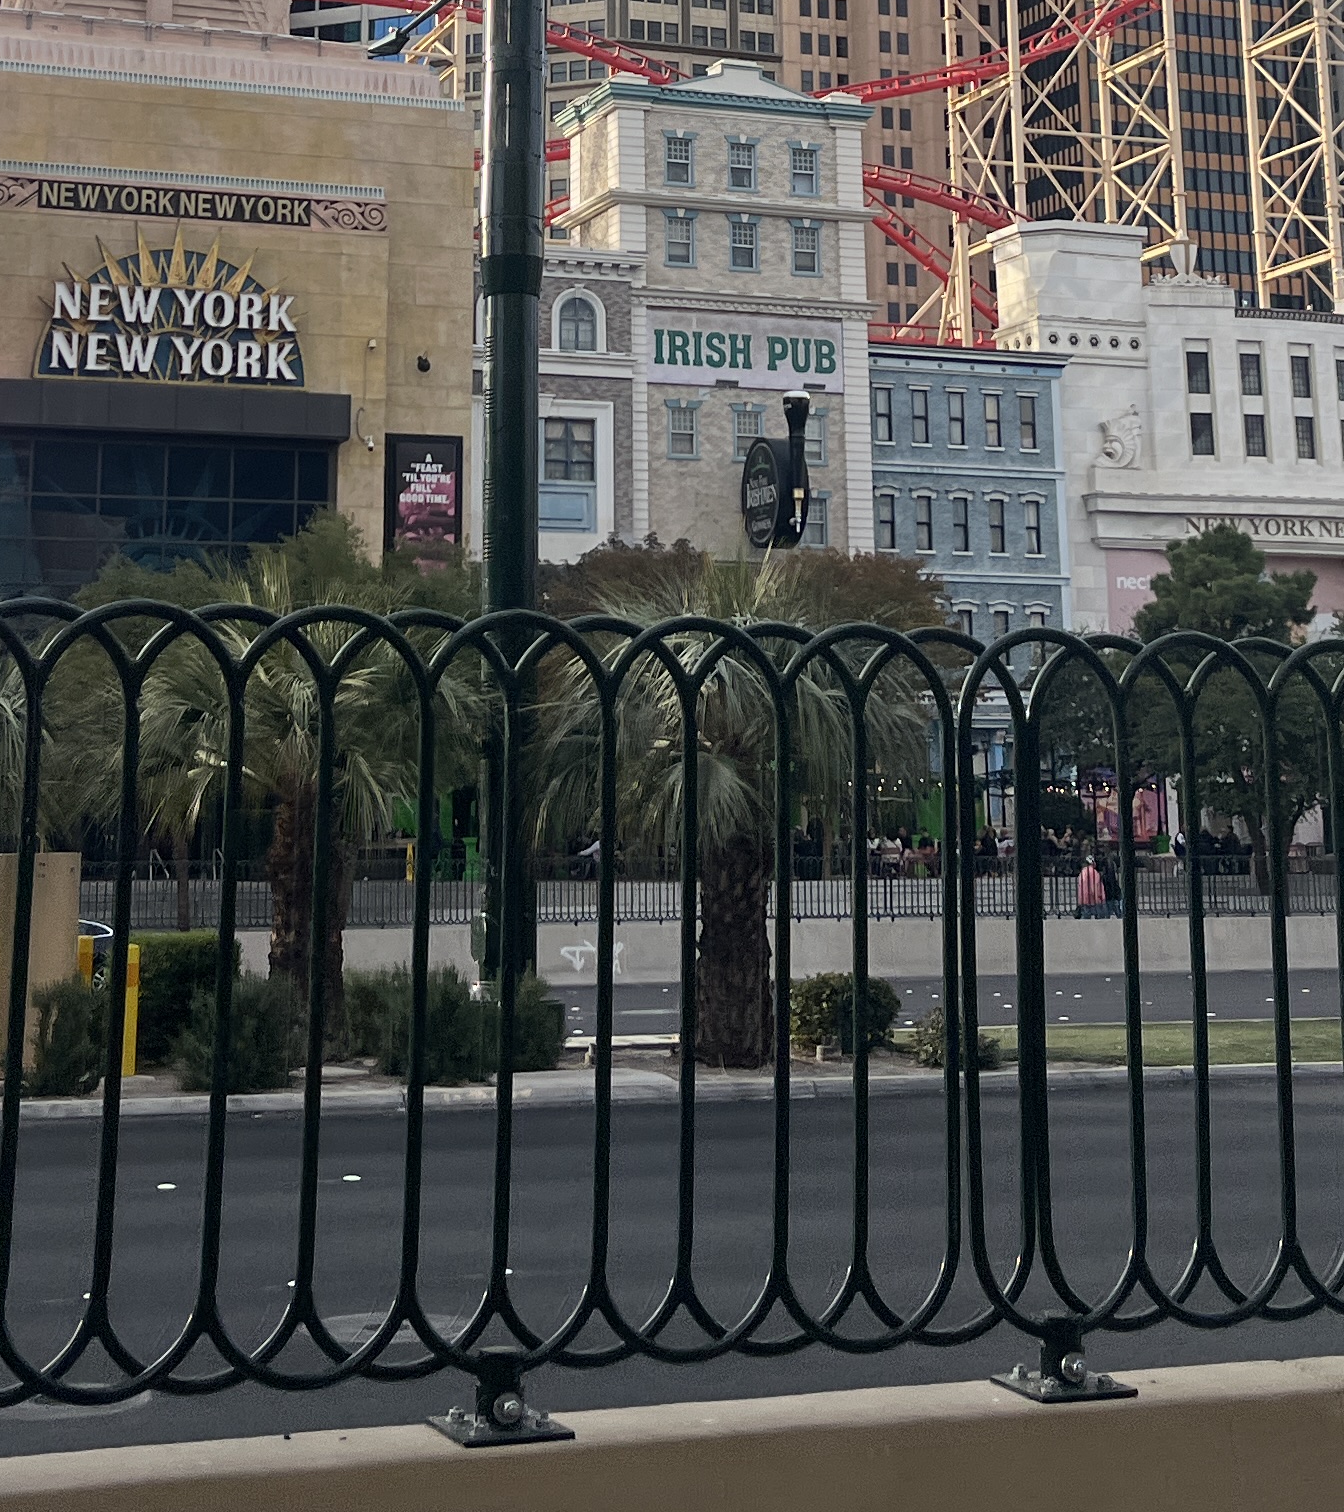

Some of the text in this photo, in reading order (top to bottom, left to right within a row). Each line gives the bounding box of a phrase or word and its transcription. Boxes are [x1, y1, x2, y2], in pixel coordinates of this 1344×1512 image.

[52, 281, 297, 332] NEW YORK
[49, 330, 297, 380] NEW YORK
[654, 329, 837, 374] IRISH PUB
[425, 453, 433, 463] A
[399, 493, 424, 503] GOOD
[1250, 517, 1316, 538] YORK
